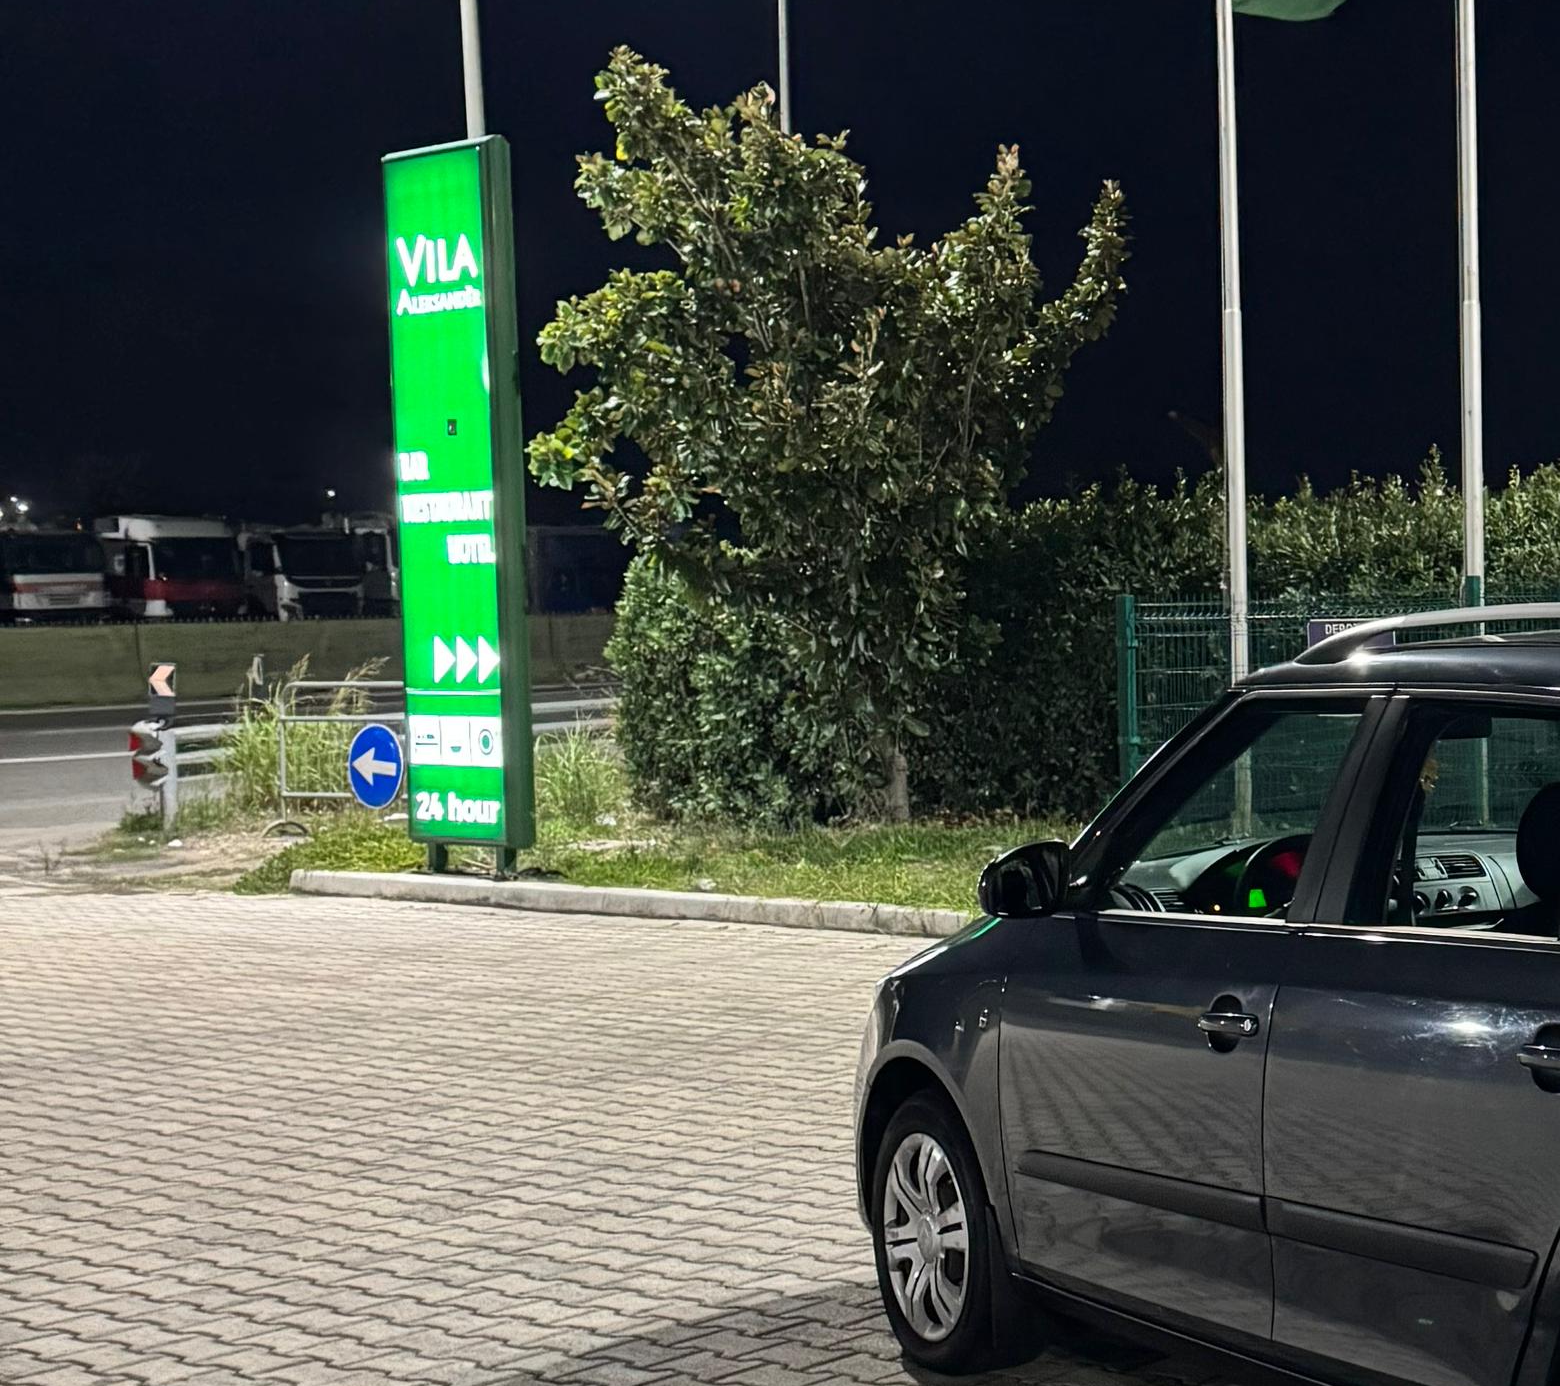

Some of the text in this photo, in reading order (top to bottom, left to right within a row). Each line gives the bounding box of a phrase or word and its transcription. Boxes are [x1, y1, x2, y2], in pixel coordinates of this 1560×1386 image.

[395, 233, 479, 288] VILA
[415, 790, 501, 824] 24 hour
